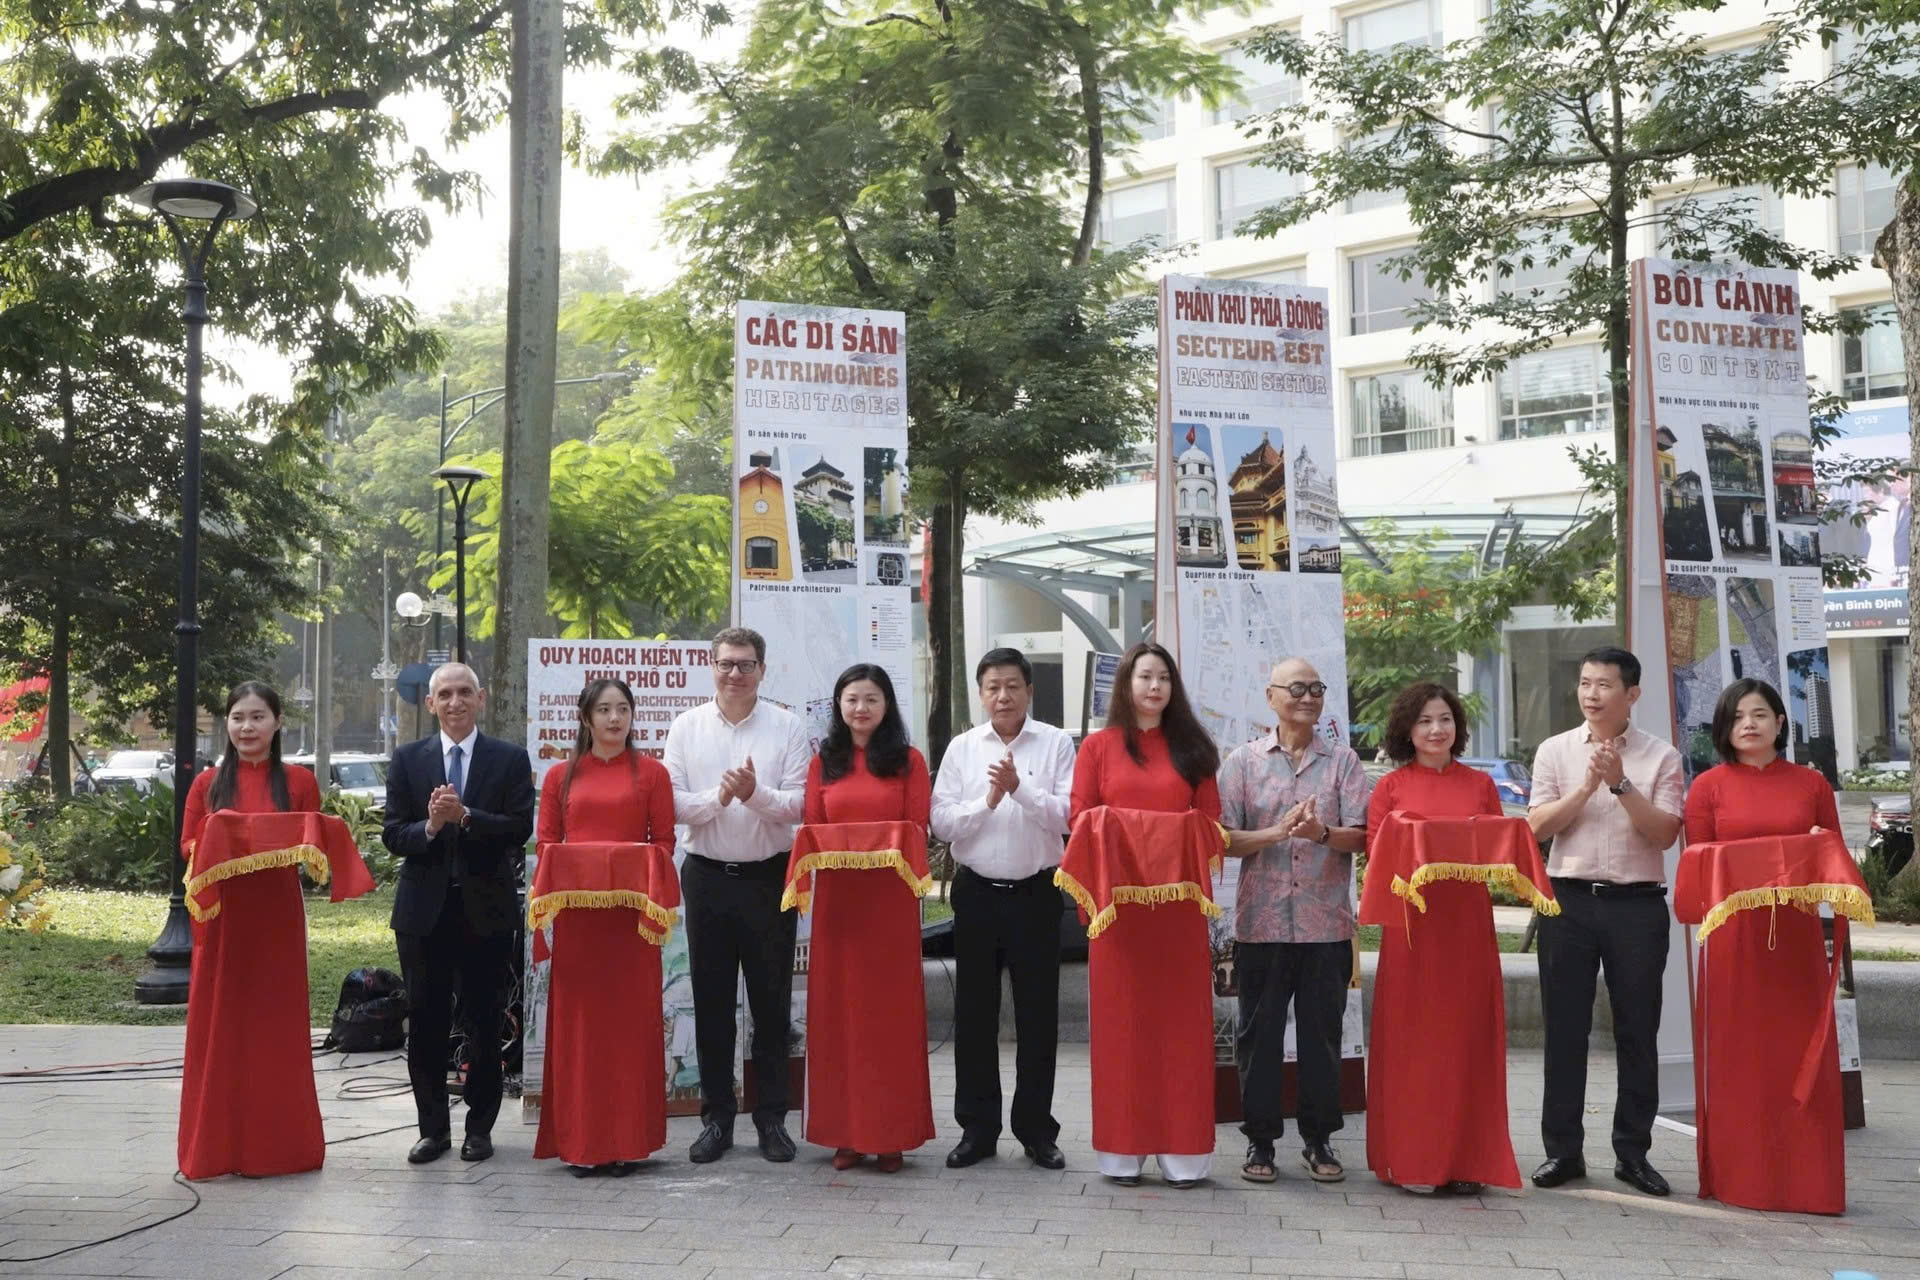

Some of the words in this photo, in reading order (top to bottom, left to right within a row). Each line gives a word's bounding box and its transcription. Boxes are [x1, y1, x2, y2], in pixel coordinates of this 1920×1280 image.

[1175, 285, 1213, 323] PHÂN
[1218, 294, 1246, 325] KHU
[1285, 294, 1323, 331] ĐÔNG
[1715, 272, 1794, 315] CẢNH
[746, 312, 797, 348] CÁC
[806, 321, 833, 350] DI
[842, 317, 898, 355] SẢN
[1656, 319, 1797, 352] CONTEXTE
[1176, 334, 1277, 362] SECTEUR
[1284, 341, 1325, 365] EST
[746, 358, 899, 388] PATRIMOINES
[1177, 366, 1258, 391] EASTERN
[1262, 372, 1327, 395] SECTOR
[1658, 353, 1799, 382] CONTEXT
[745, 389, 899, 415] HERITAGES
[749, 583, 790, 593] Patrimoine
[792, 585, 841, 593] architectural
[540, 646, 574, 667] QUY
[539, 710, 554, 721] DE
